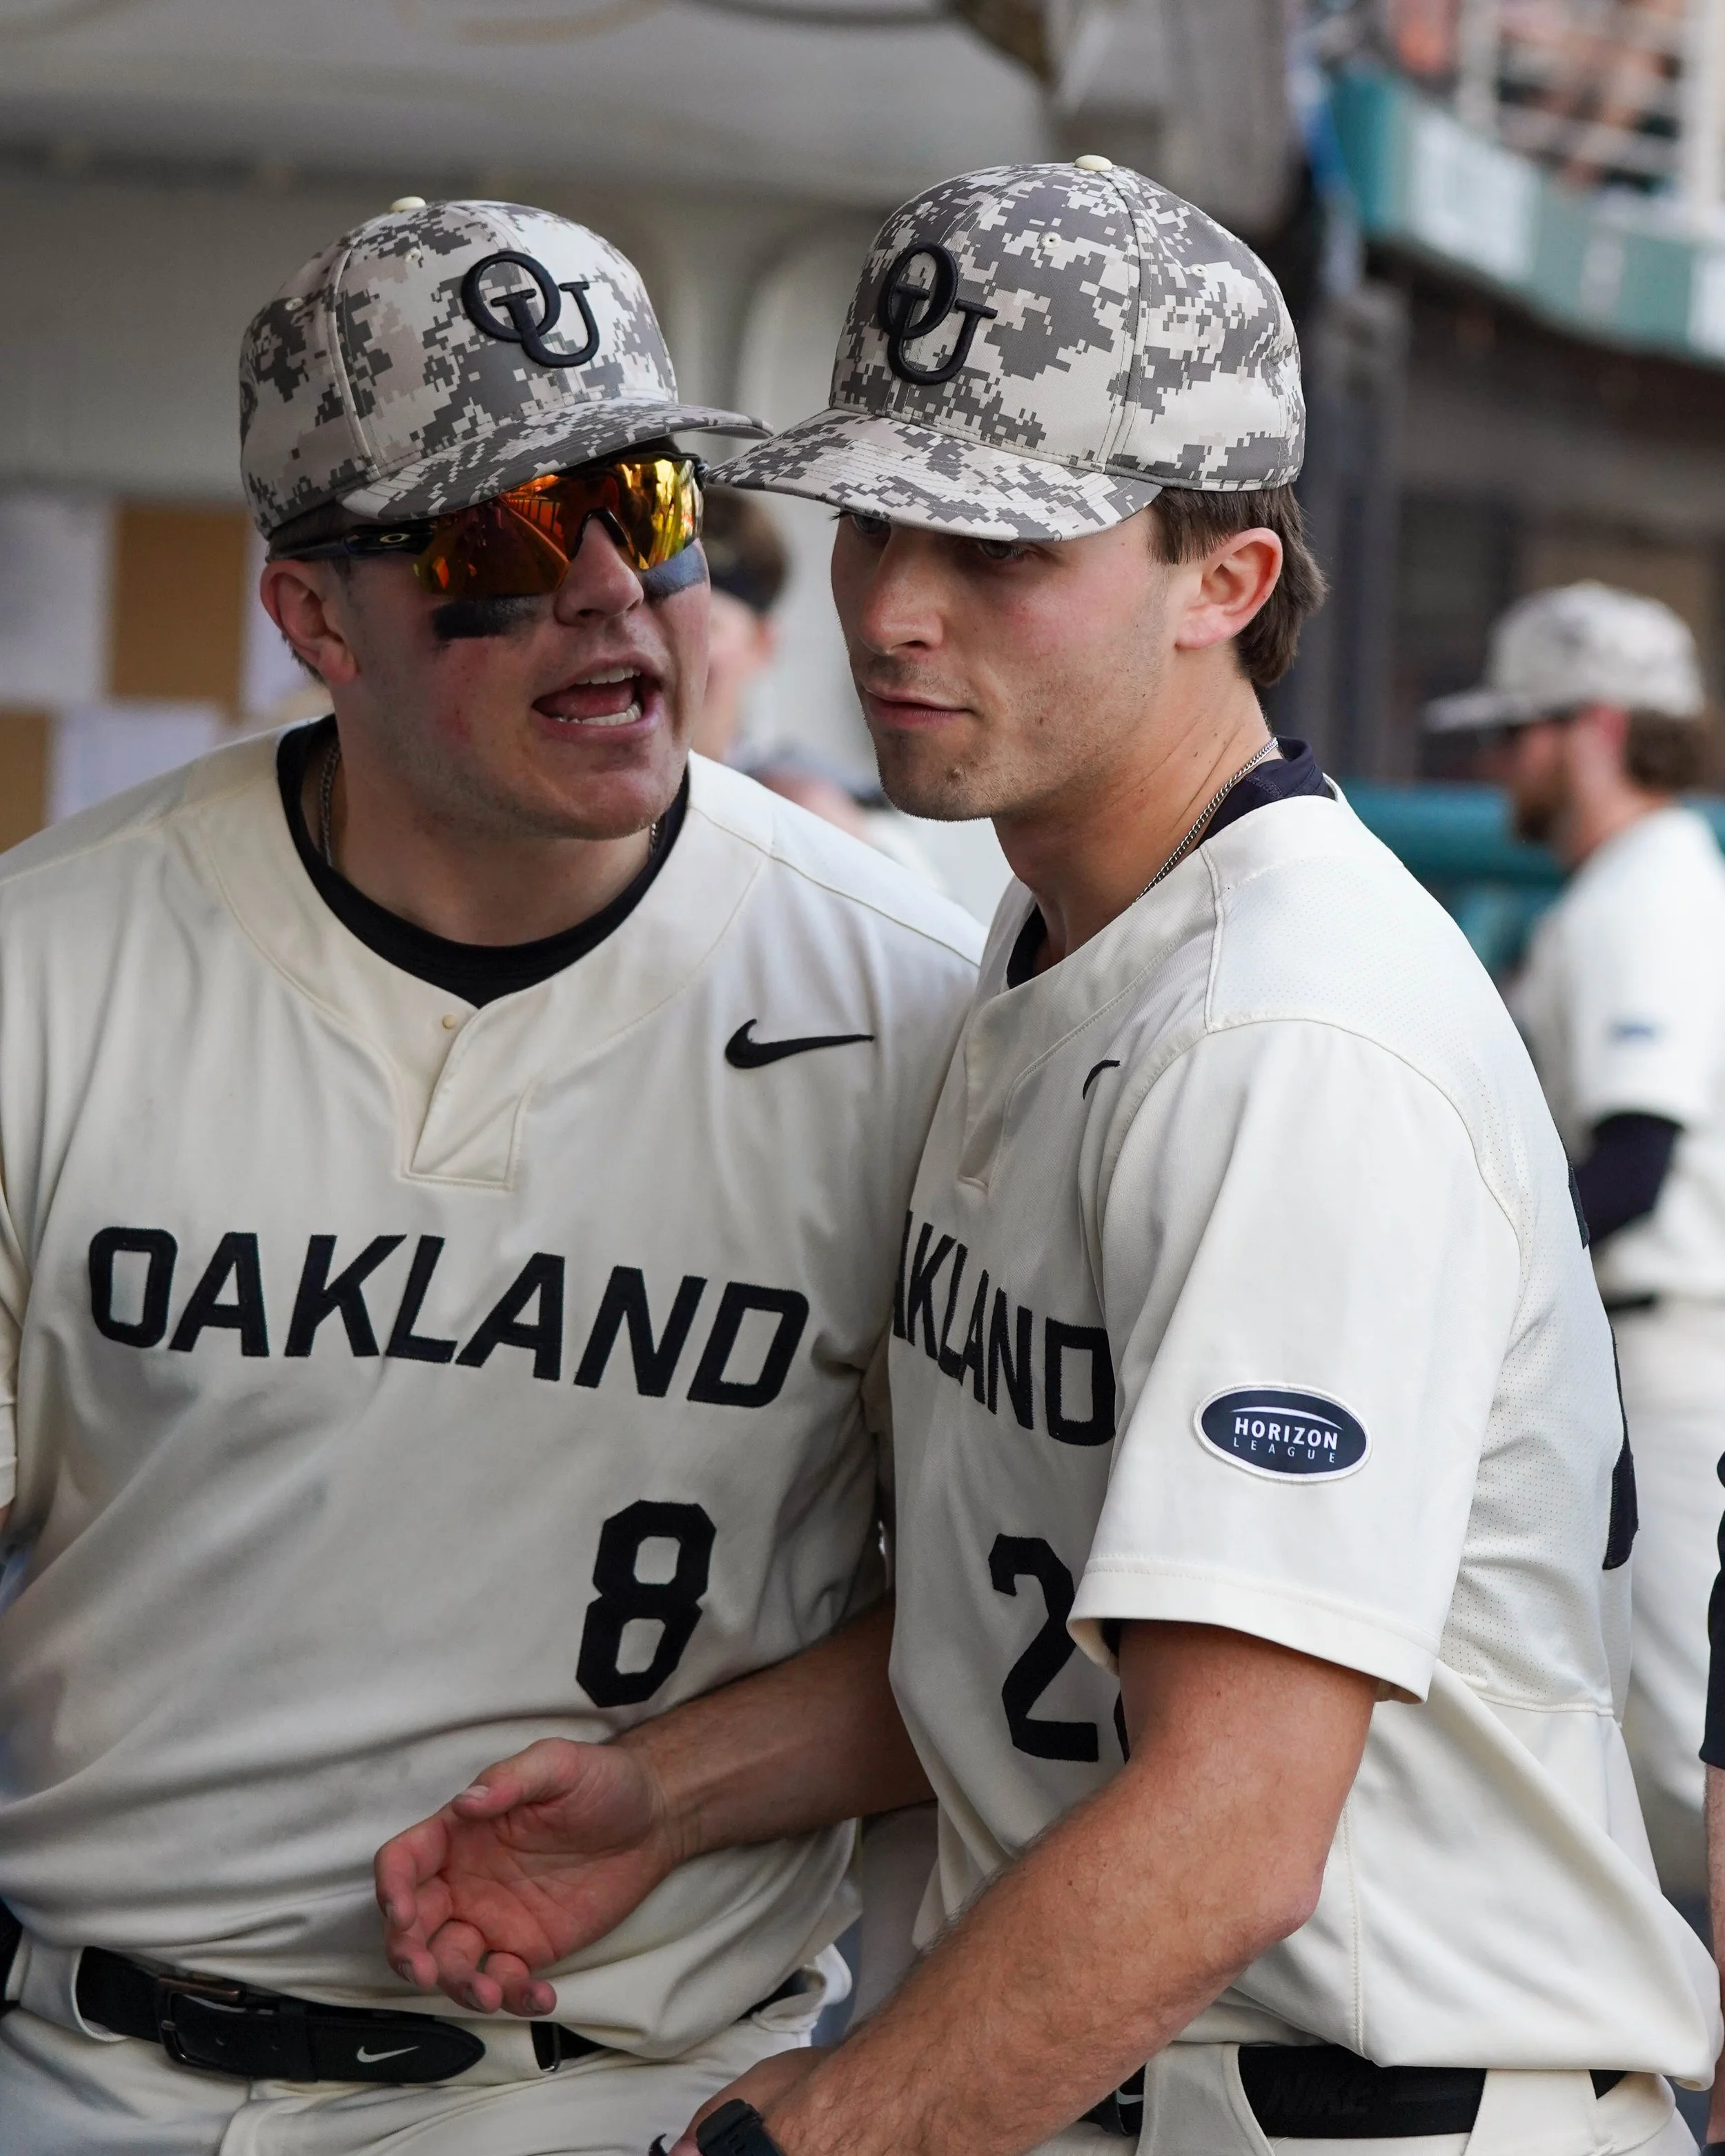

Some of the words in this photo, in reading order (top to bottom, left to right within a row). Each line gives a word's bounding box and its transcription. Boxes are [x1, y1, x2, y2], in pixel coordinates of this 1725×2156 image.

[461, 250, 600, 368] OU
[878, 244, 998, 386] OU
[88, 1227, 809, 1408] OAKLAND
[1233, 1437, 1336, 1463] LEAGUE
[1234, 1416, 1338, 1450] HORIZON
[575, 1499, 716, 1708] 8
[989, 1533, 1130, 1763] 2
